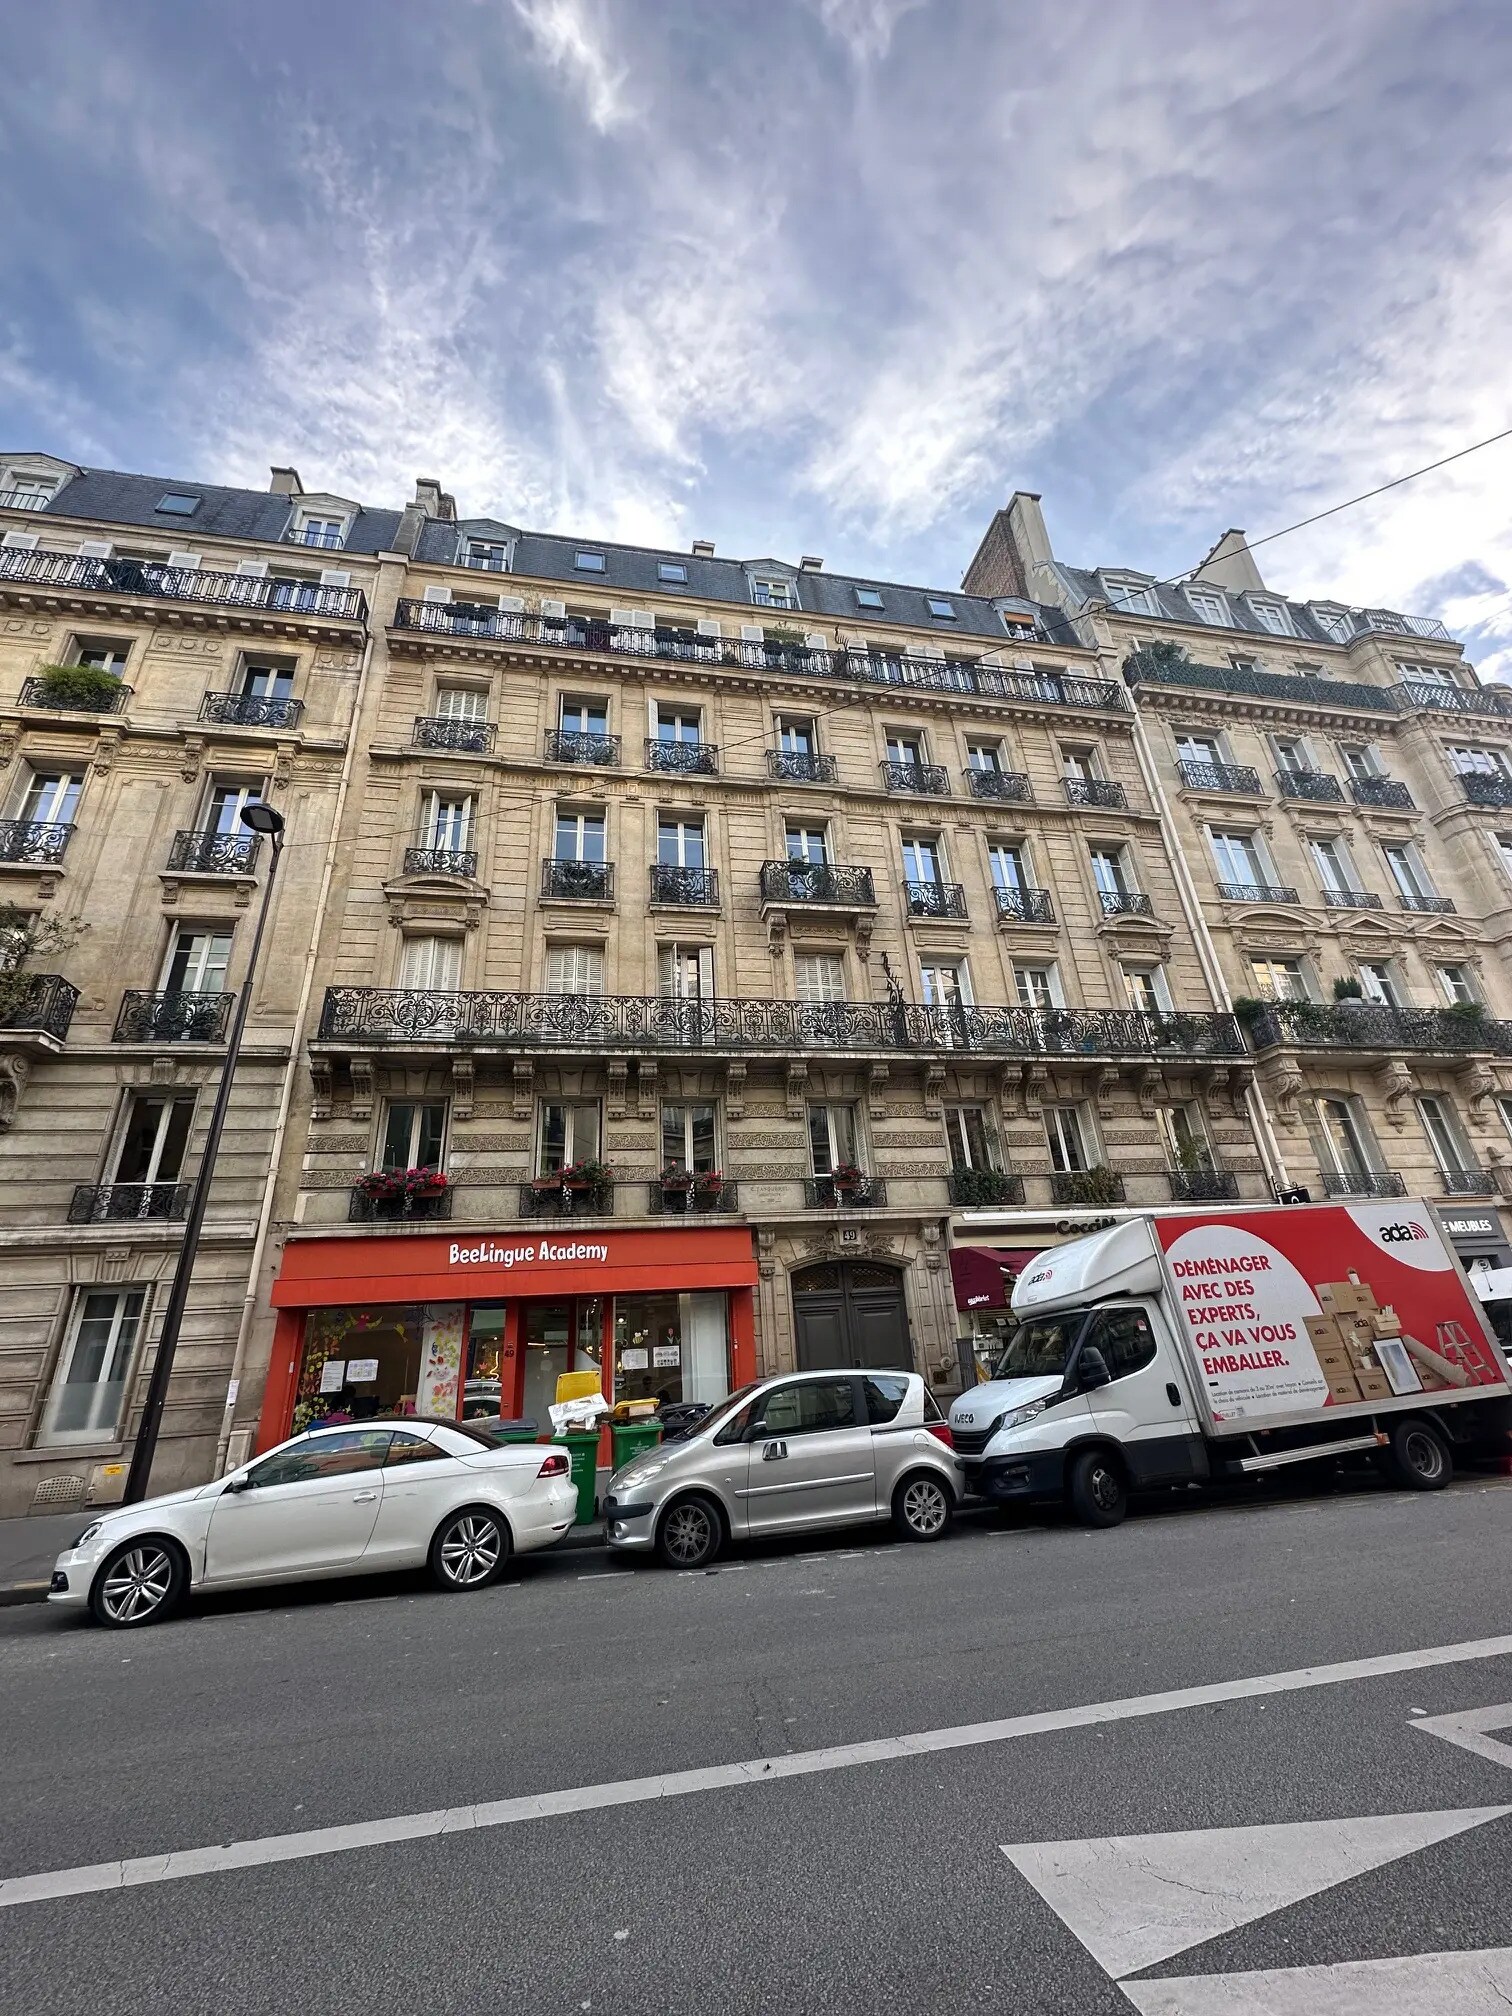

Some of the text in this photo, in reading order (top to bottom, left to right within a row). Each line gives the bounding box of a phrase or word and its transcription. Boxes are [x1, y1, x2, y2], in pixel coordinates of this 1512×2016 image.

[844, 1230, 856, 1240] 49
[1379, 1223, 1413, 1242] ada
[1448, 1220, 1493, 1232] MEUBLES
[449, 1240, 608, 1268] BeeLingue Academy
[1172, 1255, 1272, 1278] DÉMÉNAGER
[1027, 1272, 1046, 1286] ada
[1183, 1279, 1255, 1301] AVEC DES
[1187, 1303, 1260, 1325] EXPERTS,
[1353, 1318, 1370, 1328] ada
[1195, 1323, 1297, 1352] ÇA VA VOUS
[1202, 1350, 1290, 1375] EMBALLER.
[1301, 1378, 1317, 1386] Conseils
[954, 1413, 974, 1424] IVECO
